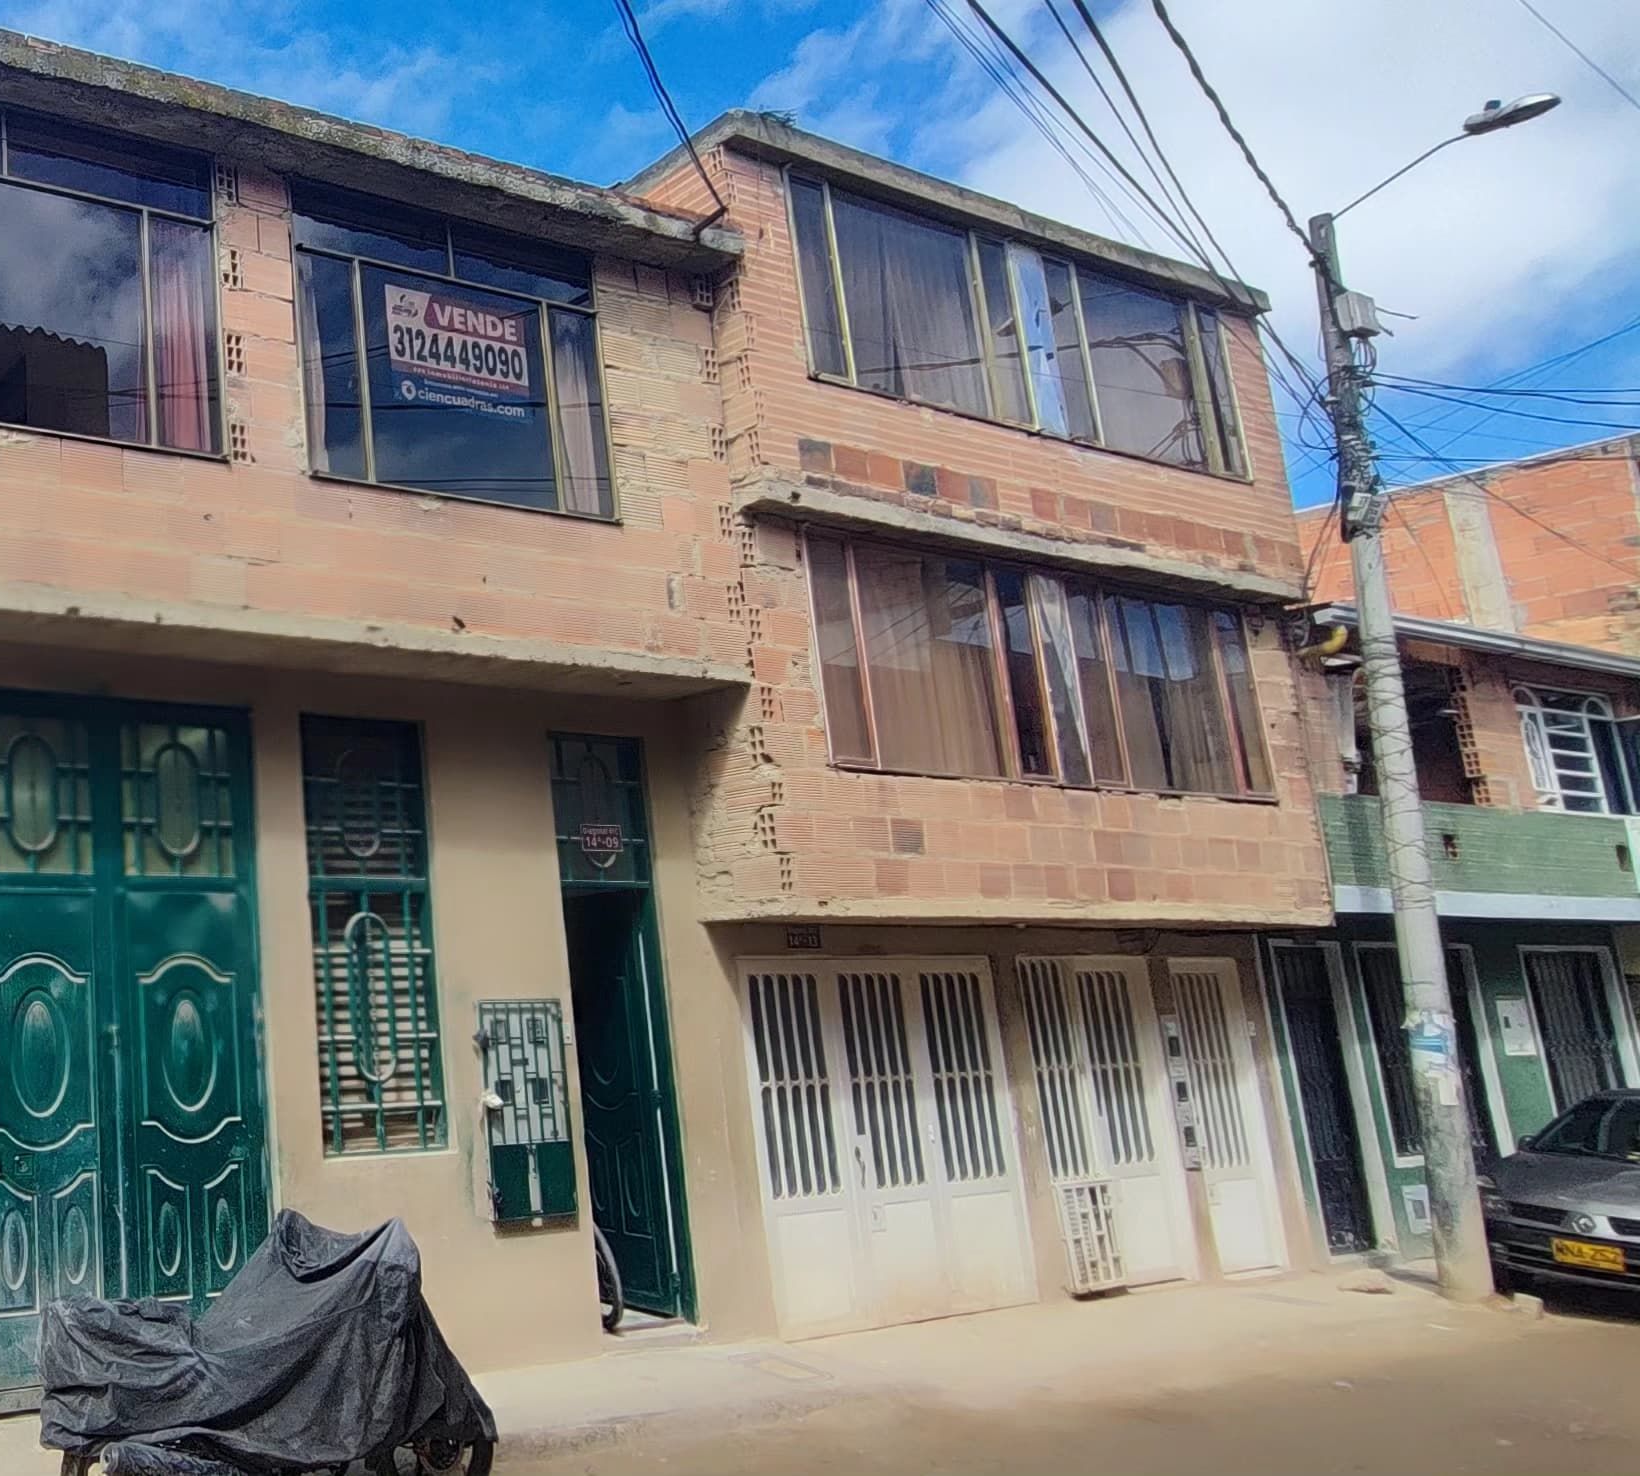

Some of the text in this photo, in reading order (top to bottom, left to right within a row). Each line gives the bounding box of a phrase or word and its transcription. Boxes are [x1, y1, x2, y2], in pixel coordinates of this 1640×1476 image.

[431, 302, 518, 342] VENDE
[393, 324, 524, 382] 3124449090
[418, 386, 526, 417] ciencuadras.com
